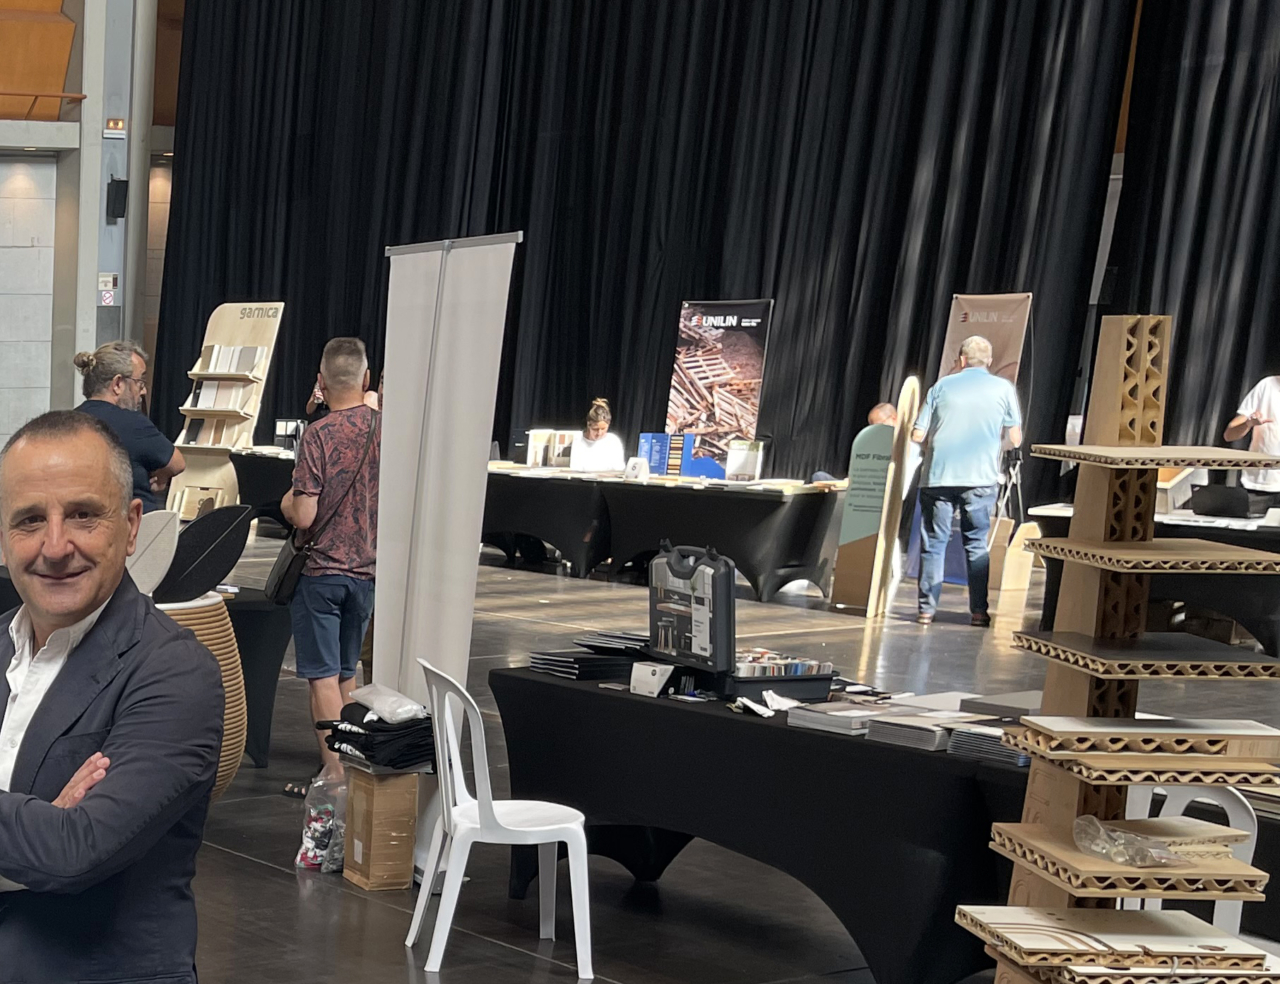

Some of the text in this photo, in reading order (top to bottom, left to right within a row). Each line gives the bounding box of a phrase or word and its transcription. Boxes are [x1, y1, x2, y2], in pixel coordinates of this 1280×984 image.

[239, 306, 279, 319] garnica
[969, 311, 999, 323] UNILIN
[702, 315, 738, 327] UNILIN
